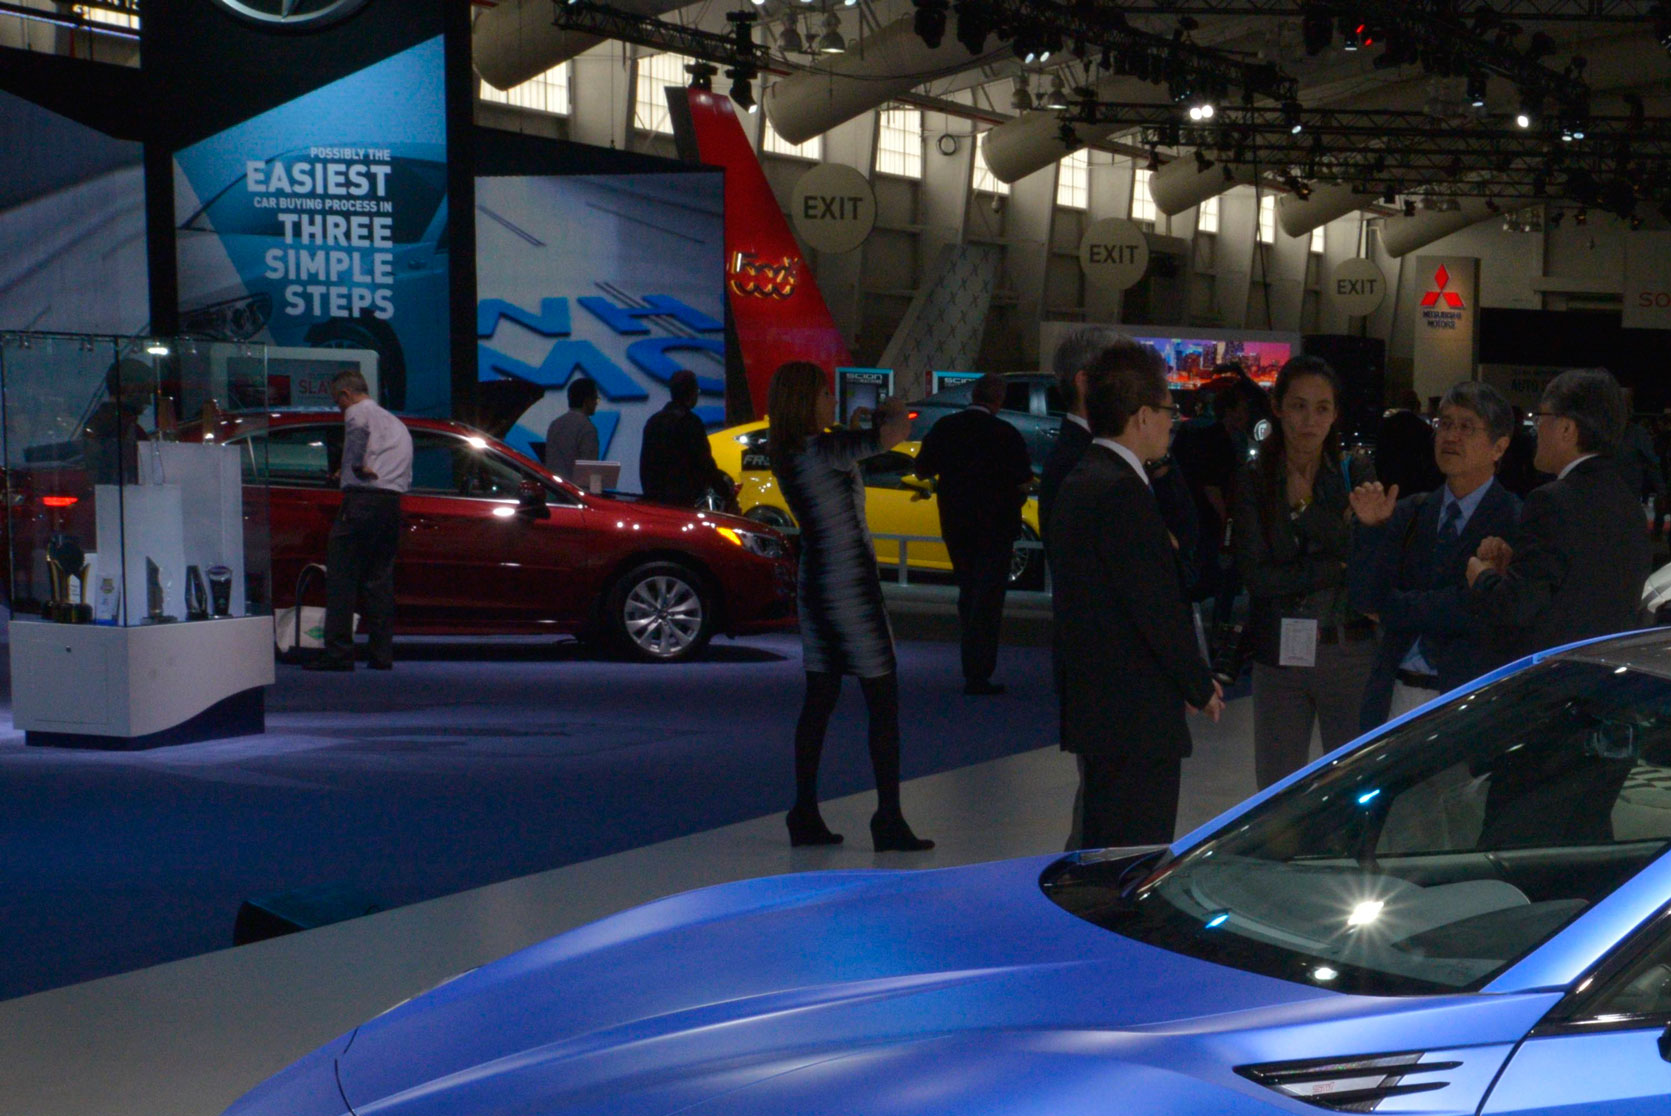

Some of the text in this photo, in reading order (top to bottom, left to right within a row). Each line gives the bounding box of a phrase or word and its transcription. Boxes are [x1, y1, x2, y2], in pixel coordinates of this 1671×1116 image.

[310, 147, 391, 161] POSSIBLY THE
[246, 160, 392, 197] EASIEST
[253, 197, 393, 213] CAR BUYING PROCESS IN
[803, 195, 863, 221] EXIT
[278, 213, 393, 248] THREE
[265, 248, 394, 285] SIMPLE
[1089, 244, 1139, 265] EXIT
[1336, 278, 1377, 296] EXIT
[285, 284, 395, 320] STEPS
